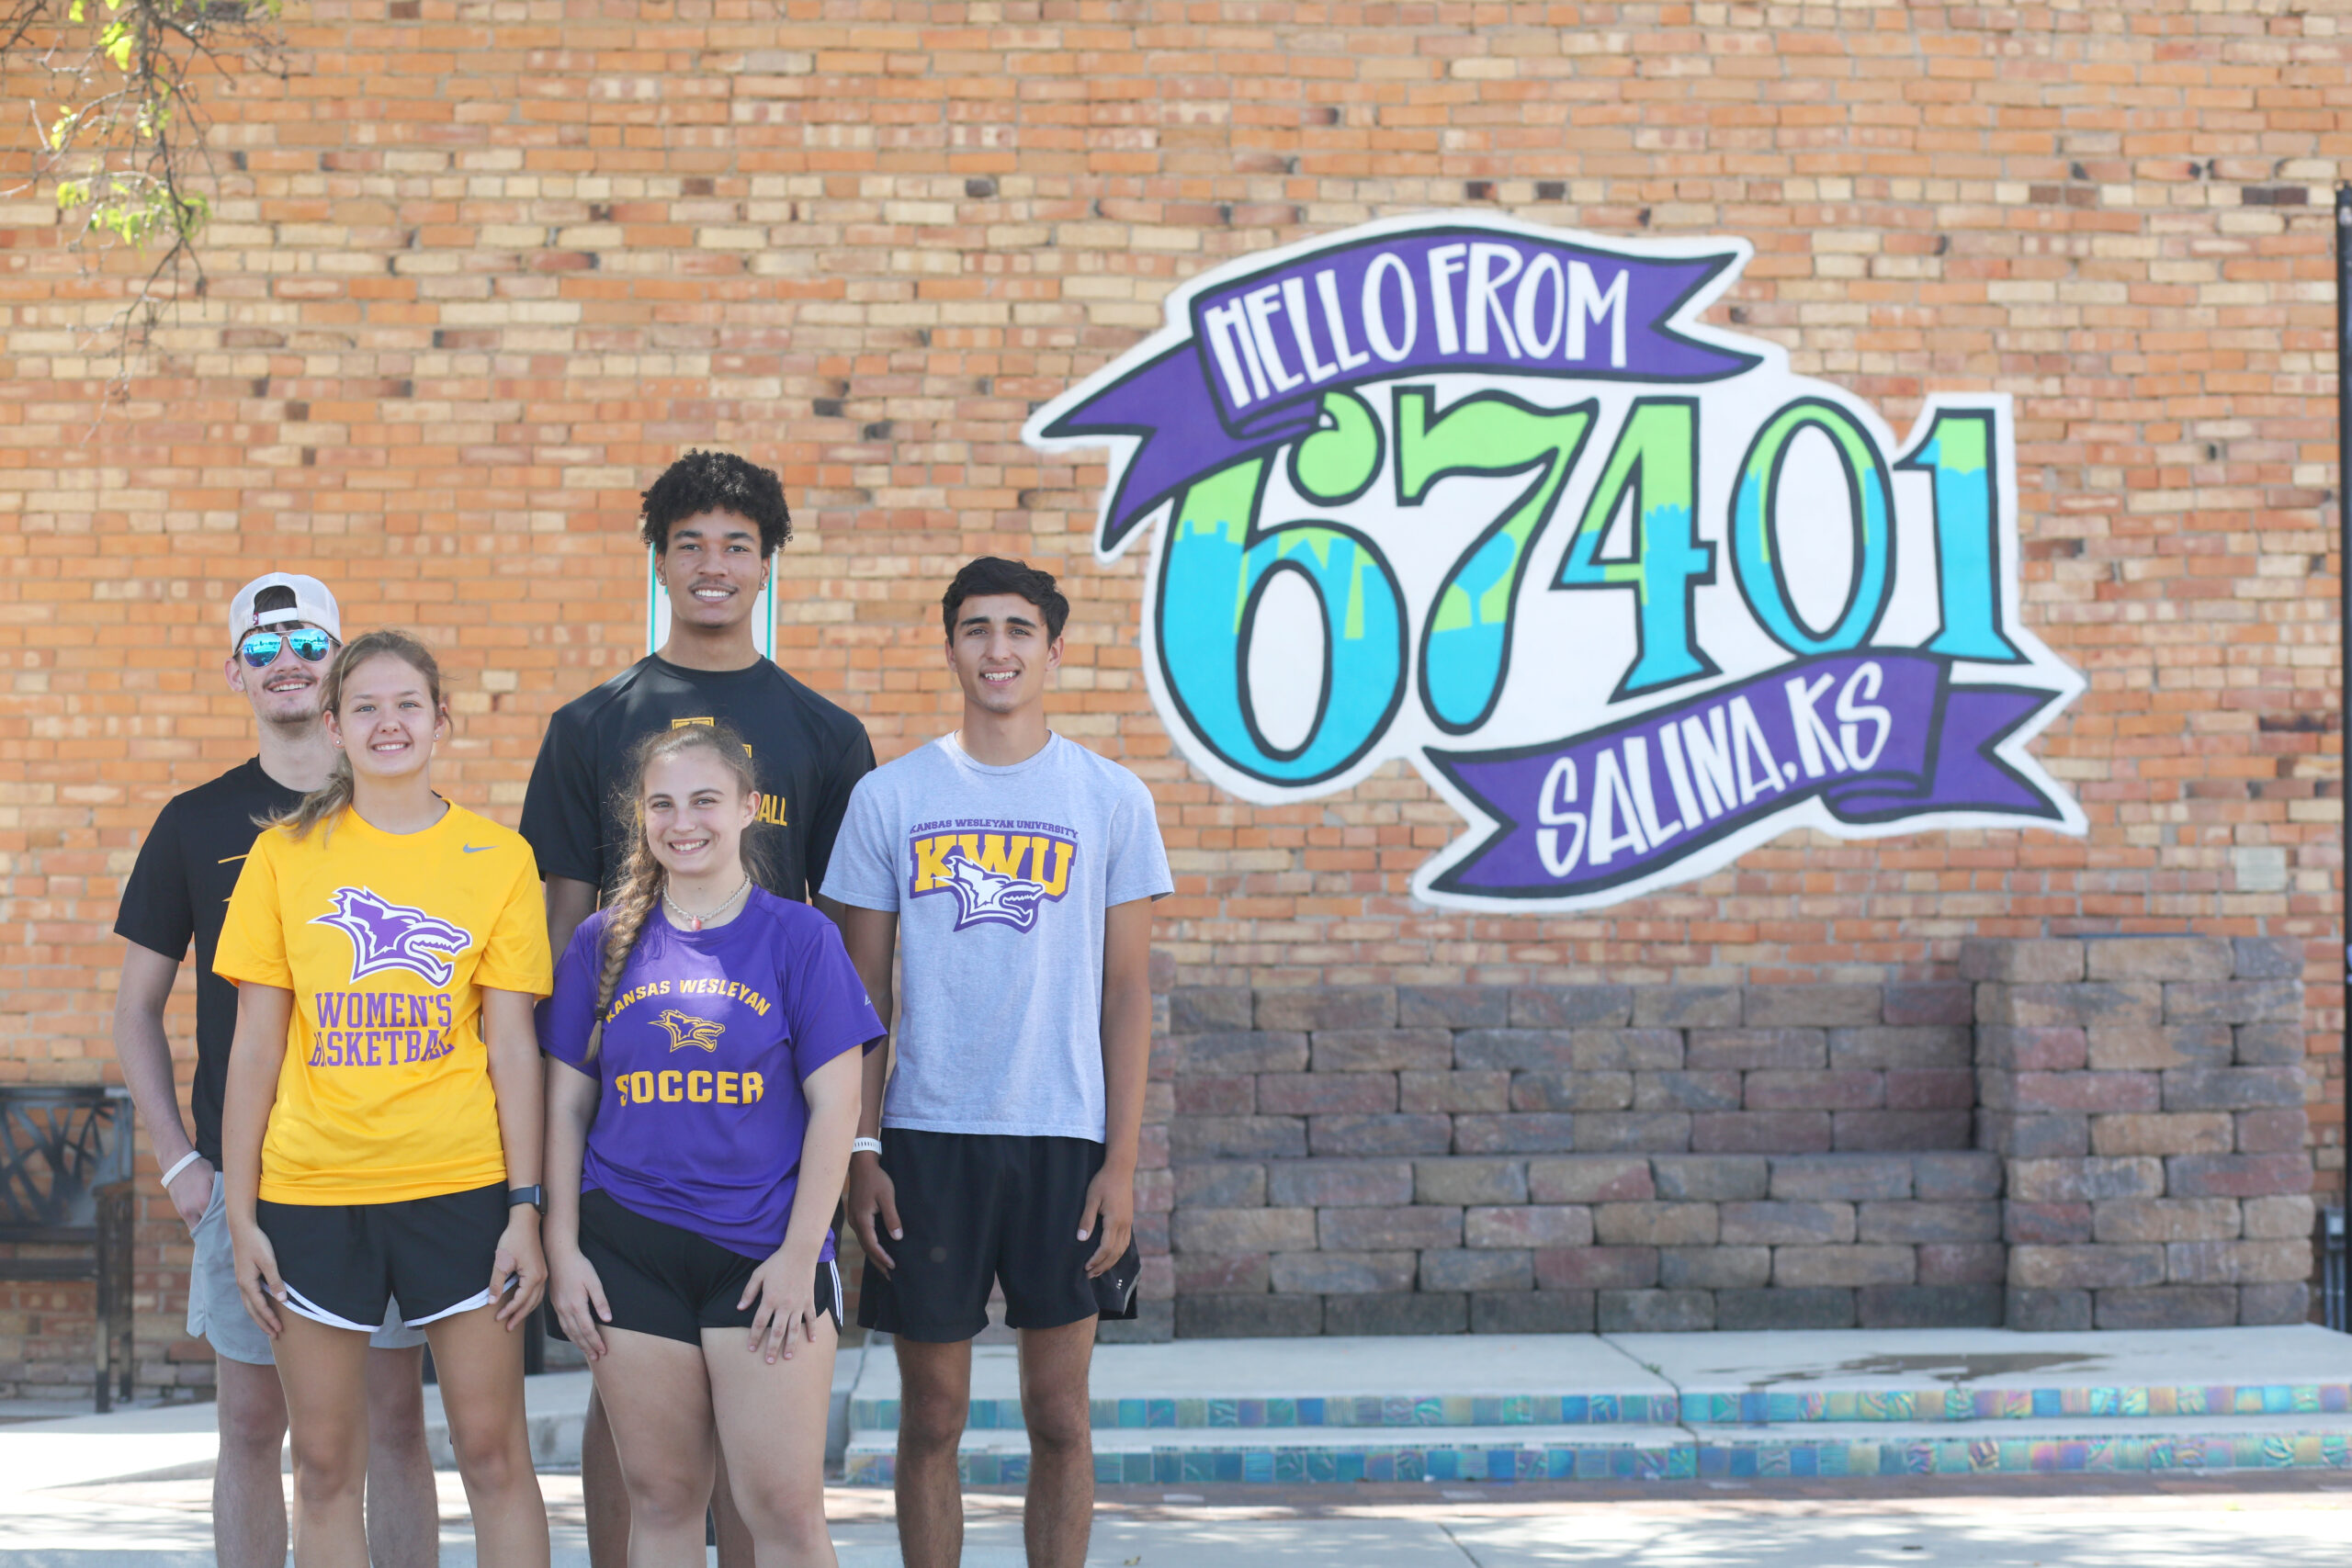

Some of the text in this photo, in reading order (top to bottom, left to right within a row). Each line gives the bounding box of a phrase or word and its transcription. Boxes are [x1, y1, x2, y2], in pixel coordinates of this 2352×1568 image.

[1204, 242, 1630, 410] HELLO FROM
[1155, 384, 2033, 785] 67401
[910, 818, 1080, 839] KANSAS WESLEYAN UNIVERSITY
[912, 832, 1075, 898] KWU
[315, 992, 452, 1028] WOMEN'S
[605, 977, 772, 1024] KANSAS WESLEYAN
[615, 1070, 764, 1108] SOCCER
